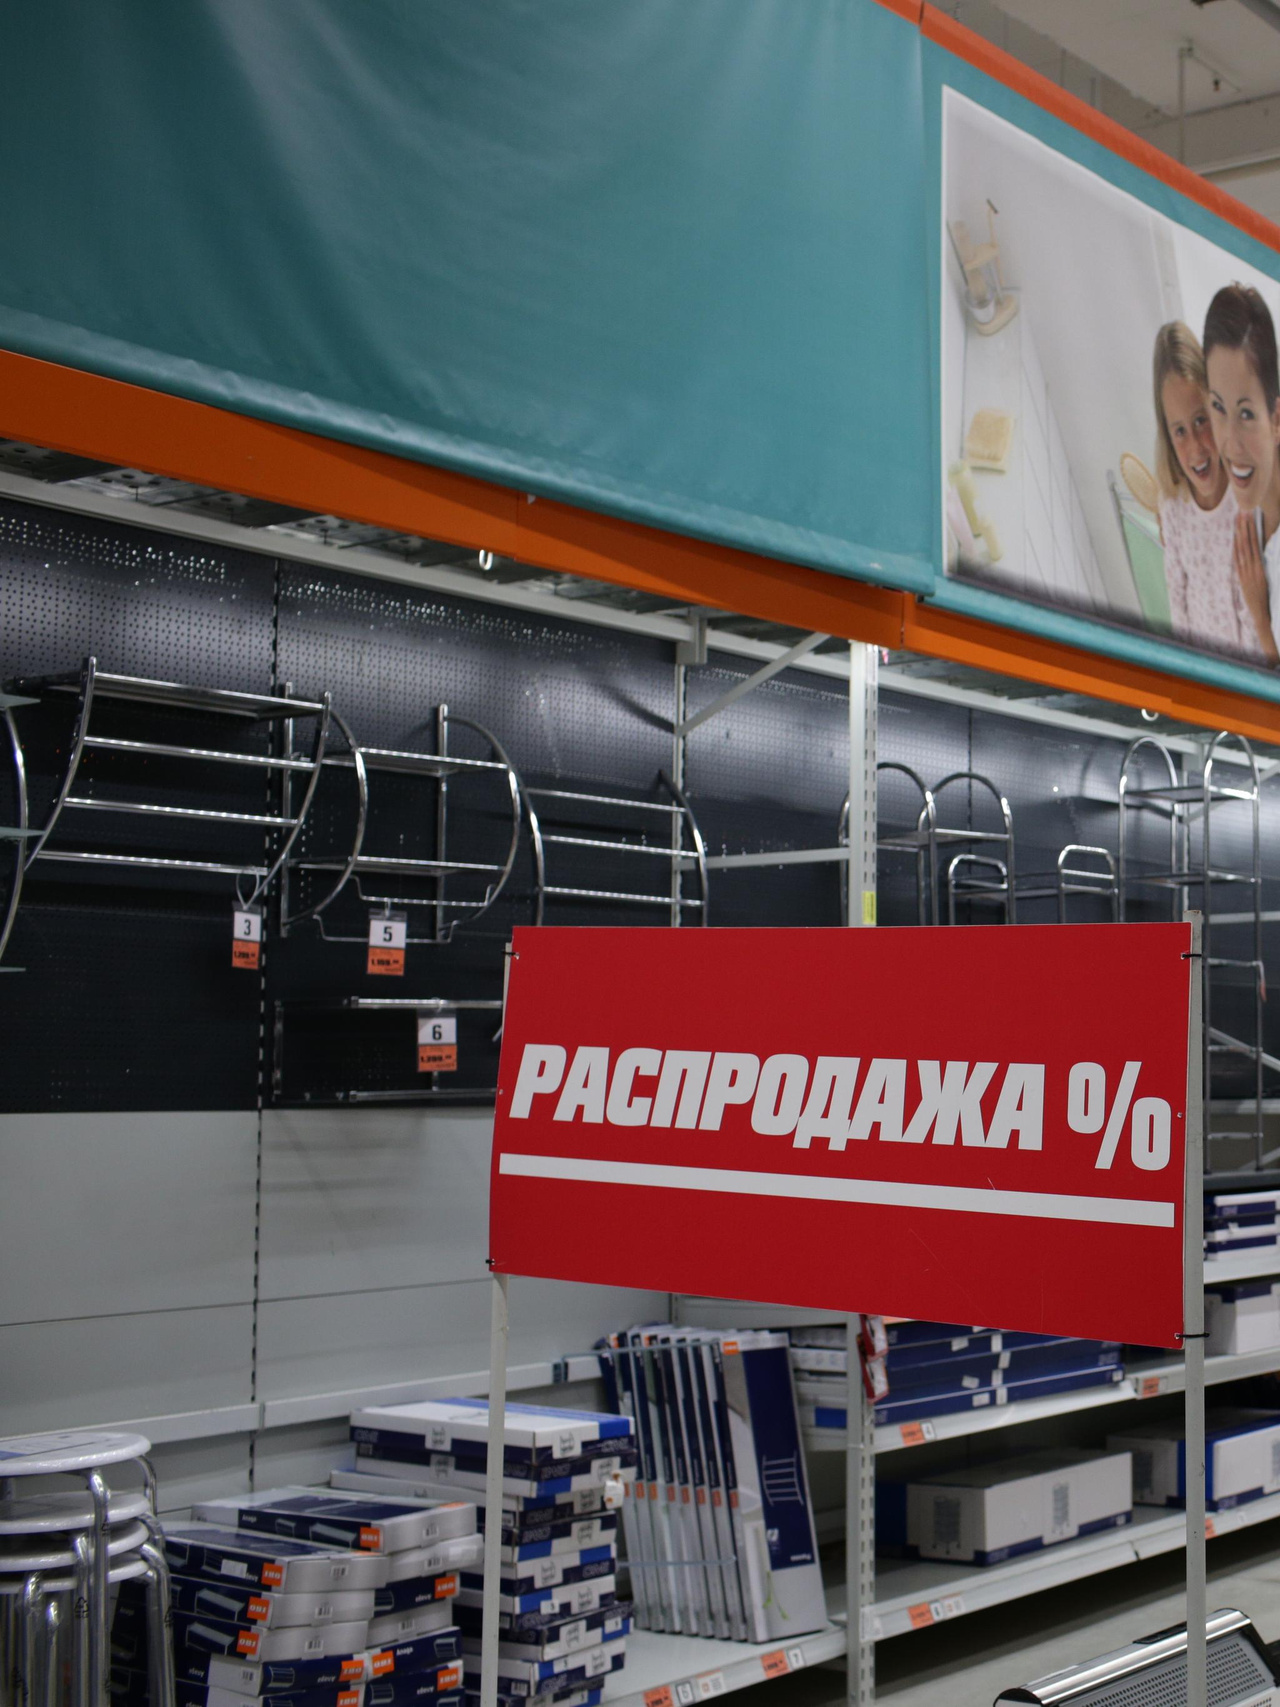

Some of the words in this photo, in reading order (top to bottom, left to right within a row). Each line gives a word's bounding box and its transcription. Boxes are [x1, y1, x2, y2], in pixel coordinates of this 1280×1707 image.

[243, 919, 251, 936] 3
[382, 925, 393, 943] 5
[432, 1024, 442, 1041] 6
[509, 1043, 1045, 1151] РАСПРОДАЖА
[1066, 1061, 1172, 1171] %
